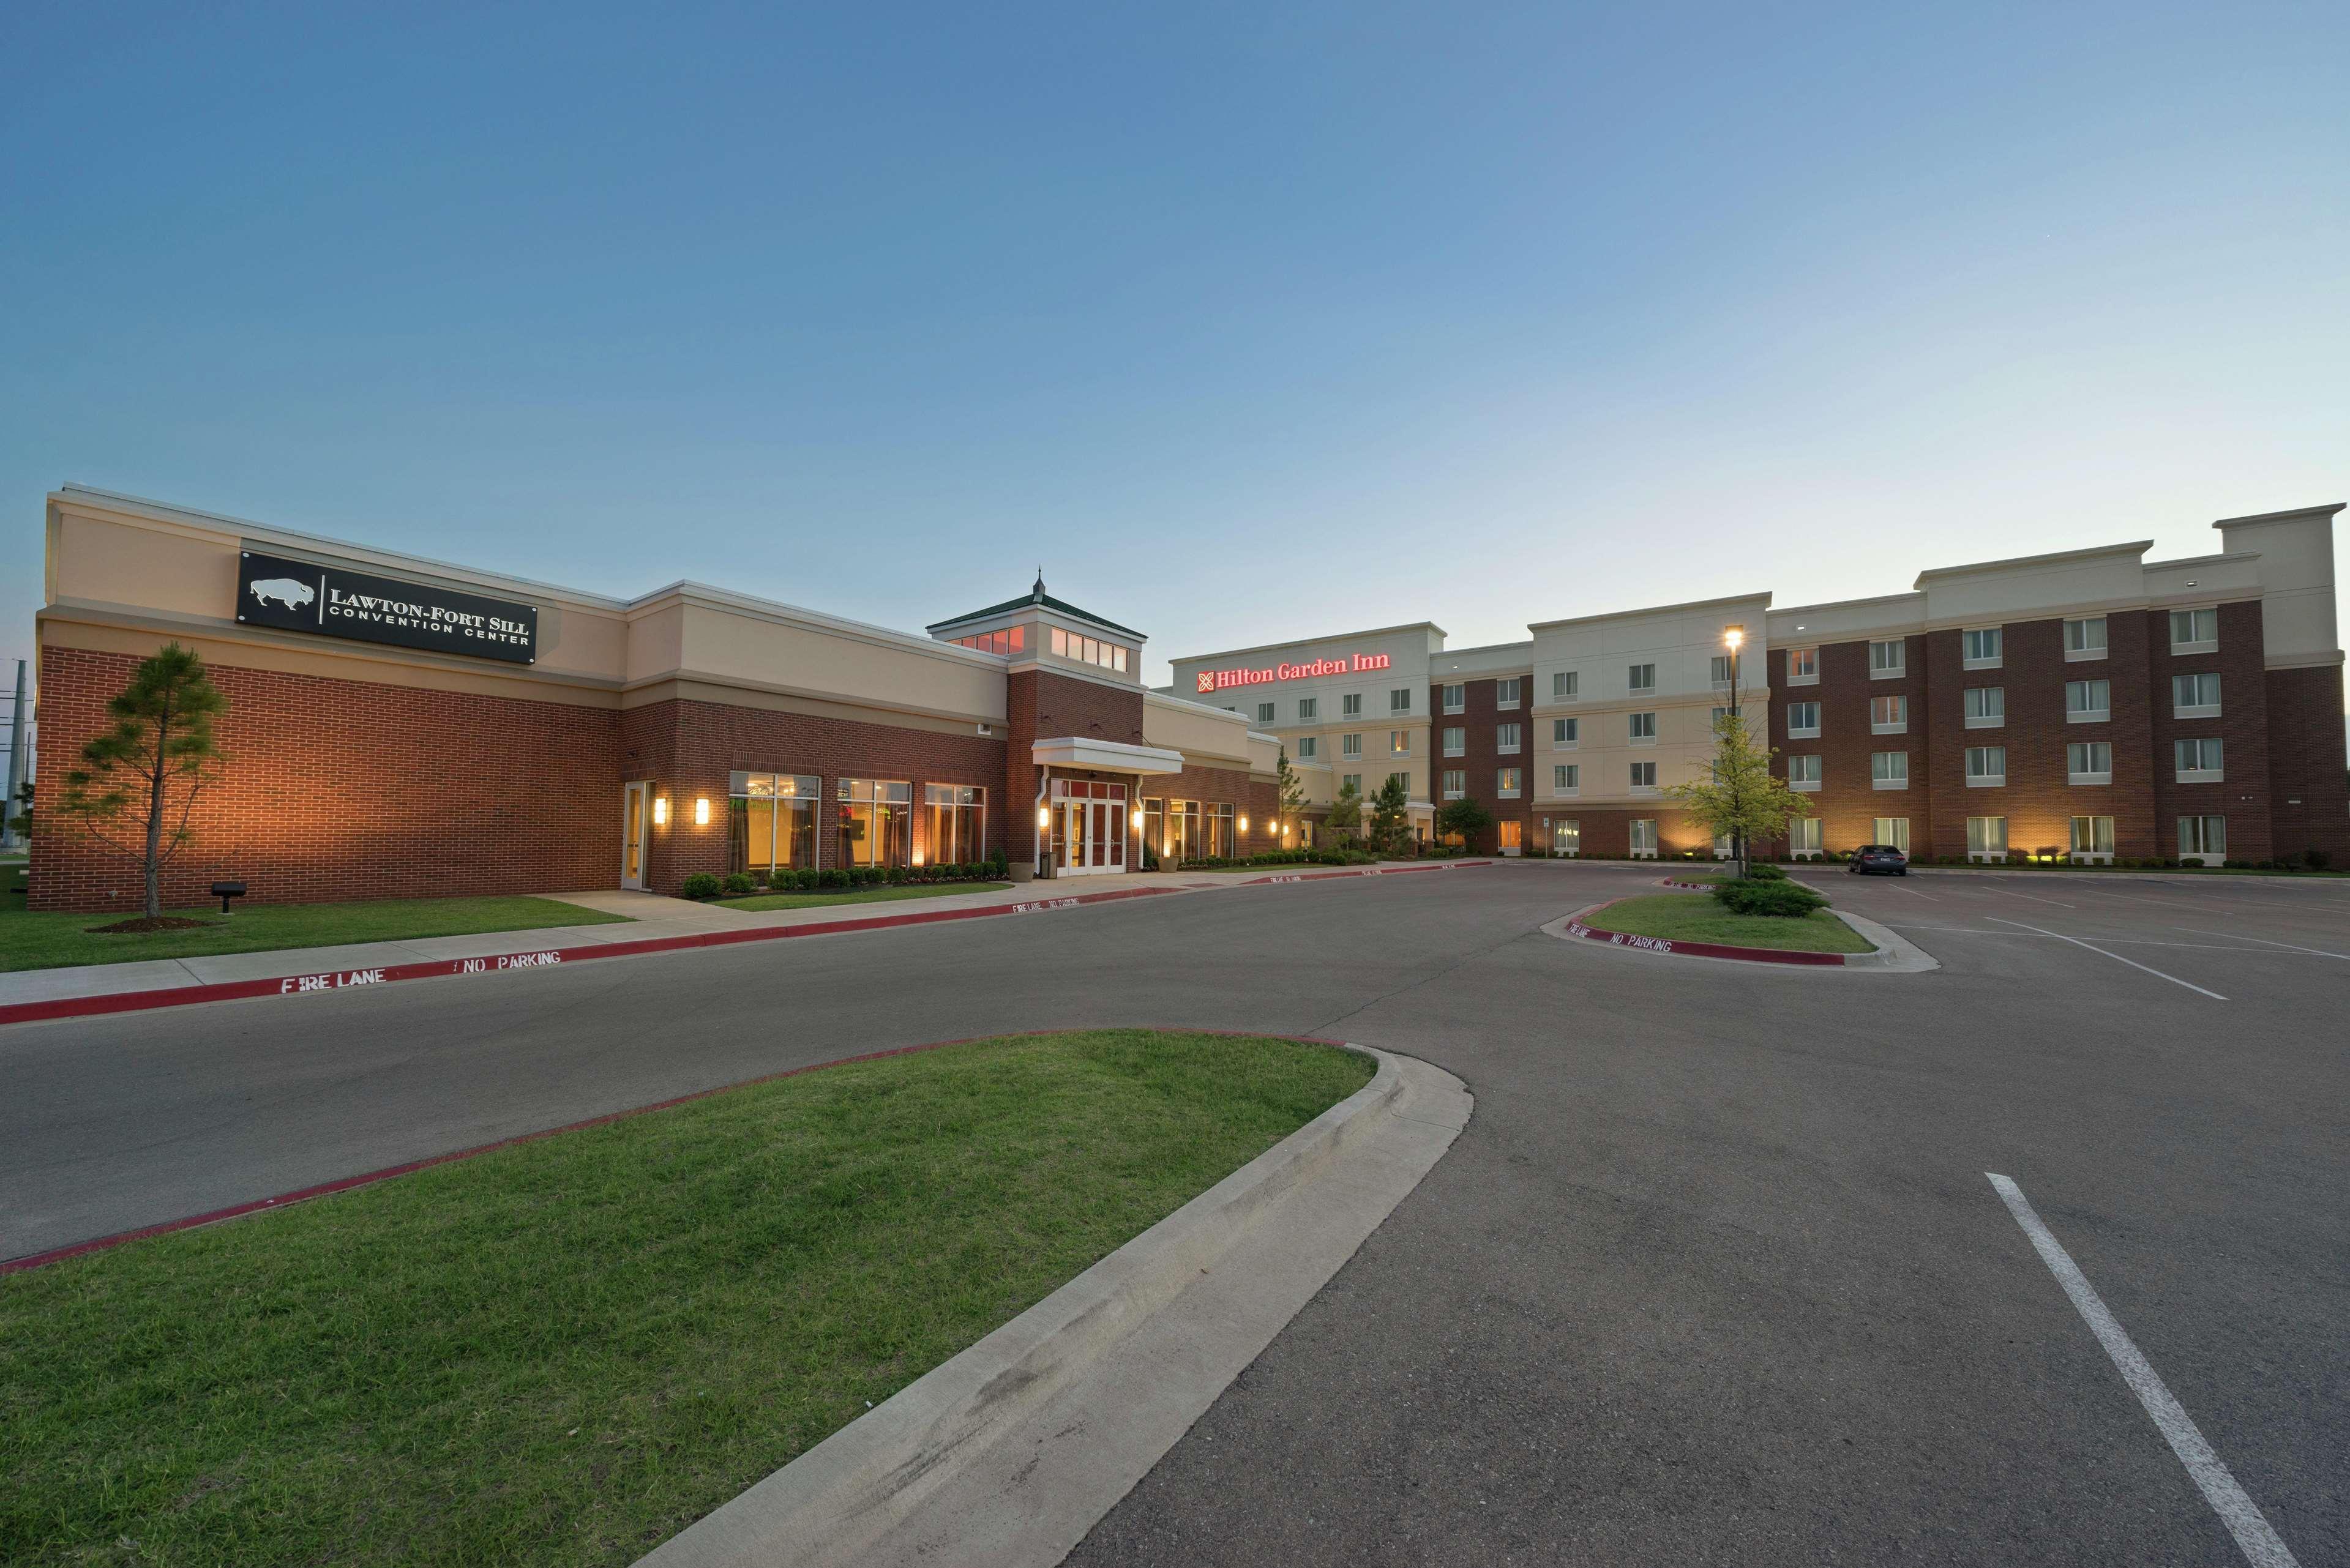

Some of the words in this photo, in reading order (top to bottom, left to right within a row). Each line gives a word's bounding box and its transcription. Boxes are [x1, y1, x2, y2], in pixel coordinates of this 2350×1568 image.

[329, 606, 452, 633] CONVENTION
[465, 628, 528, 646] CENTER
[331, 589, 484, 627] LAWTON-FORT
[489, 617, 529, 635] SILL
[1216, 669, 1274, 688] Hilton
[1278, 659, 1347, 681] Garden
[1352, 653, 1390, 671] Inn
[1012, 903, 1028, 913] FIRE
[1028, 902, 1043, 911] LANE
[1058, 897, 1080, 907] PARKING
[1610, 933, 1624, 944] NO
[1628, 935, 1672, 952] PARKING
[281, 974, 332, 994] FIRE
[337, 969, 387, 987] LANE
[463, 958, 485, 973] NO
[498, 951, 561, 970] PARKING
